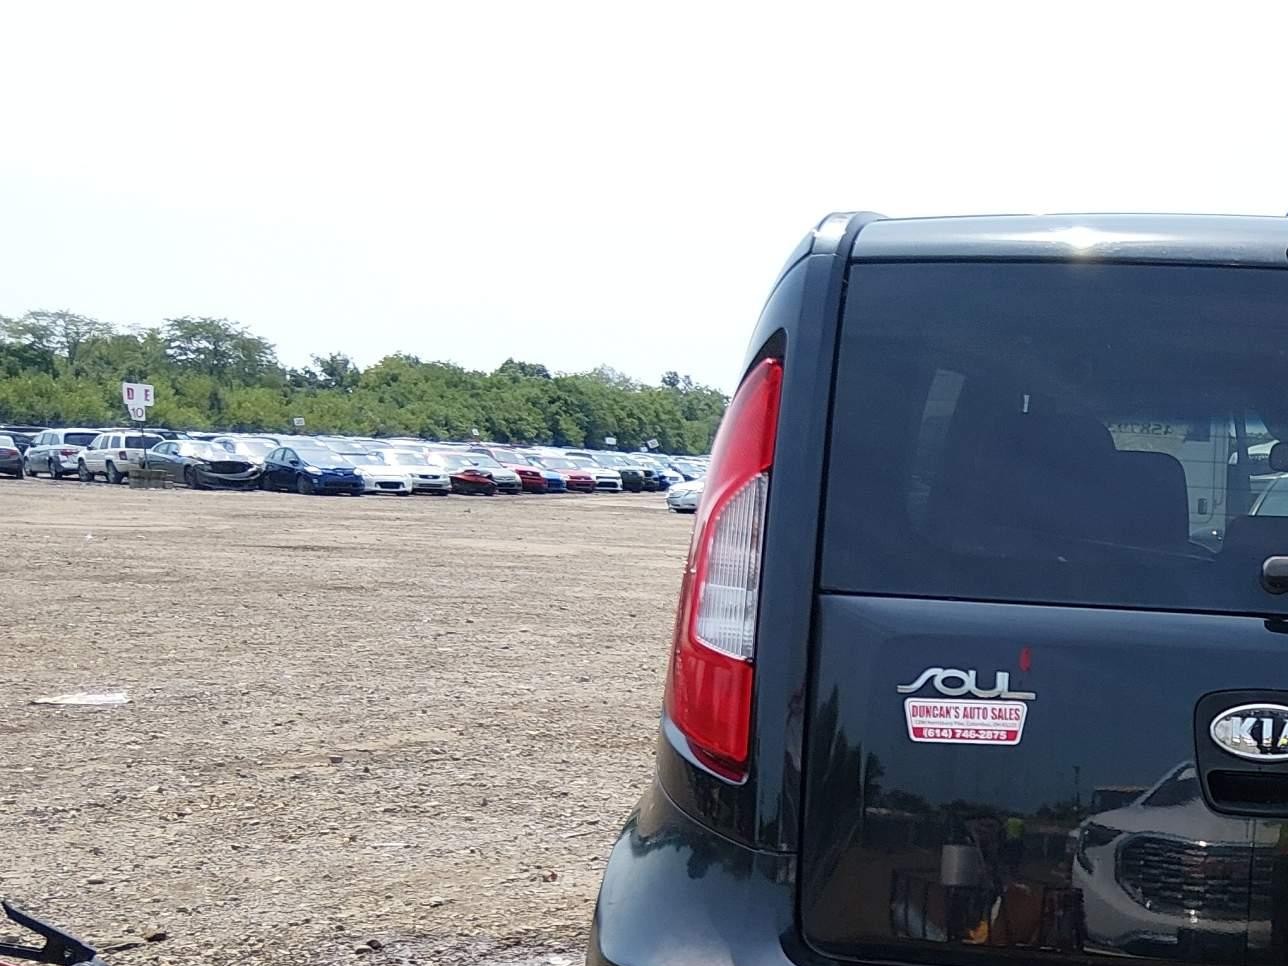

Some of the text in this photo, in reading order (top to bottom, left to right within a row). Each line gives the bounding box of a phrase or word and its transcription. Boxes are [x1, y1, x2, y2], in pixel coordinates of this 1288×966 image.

[127, 388, 150, 401] D E
[131, 407, 144, 418] 10
[911, 704, 1021, 721] DUNCAN'S AUTO SALES
[923, 728, 953, 738] (614)
